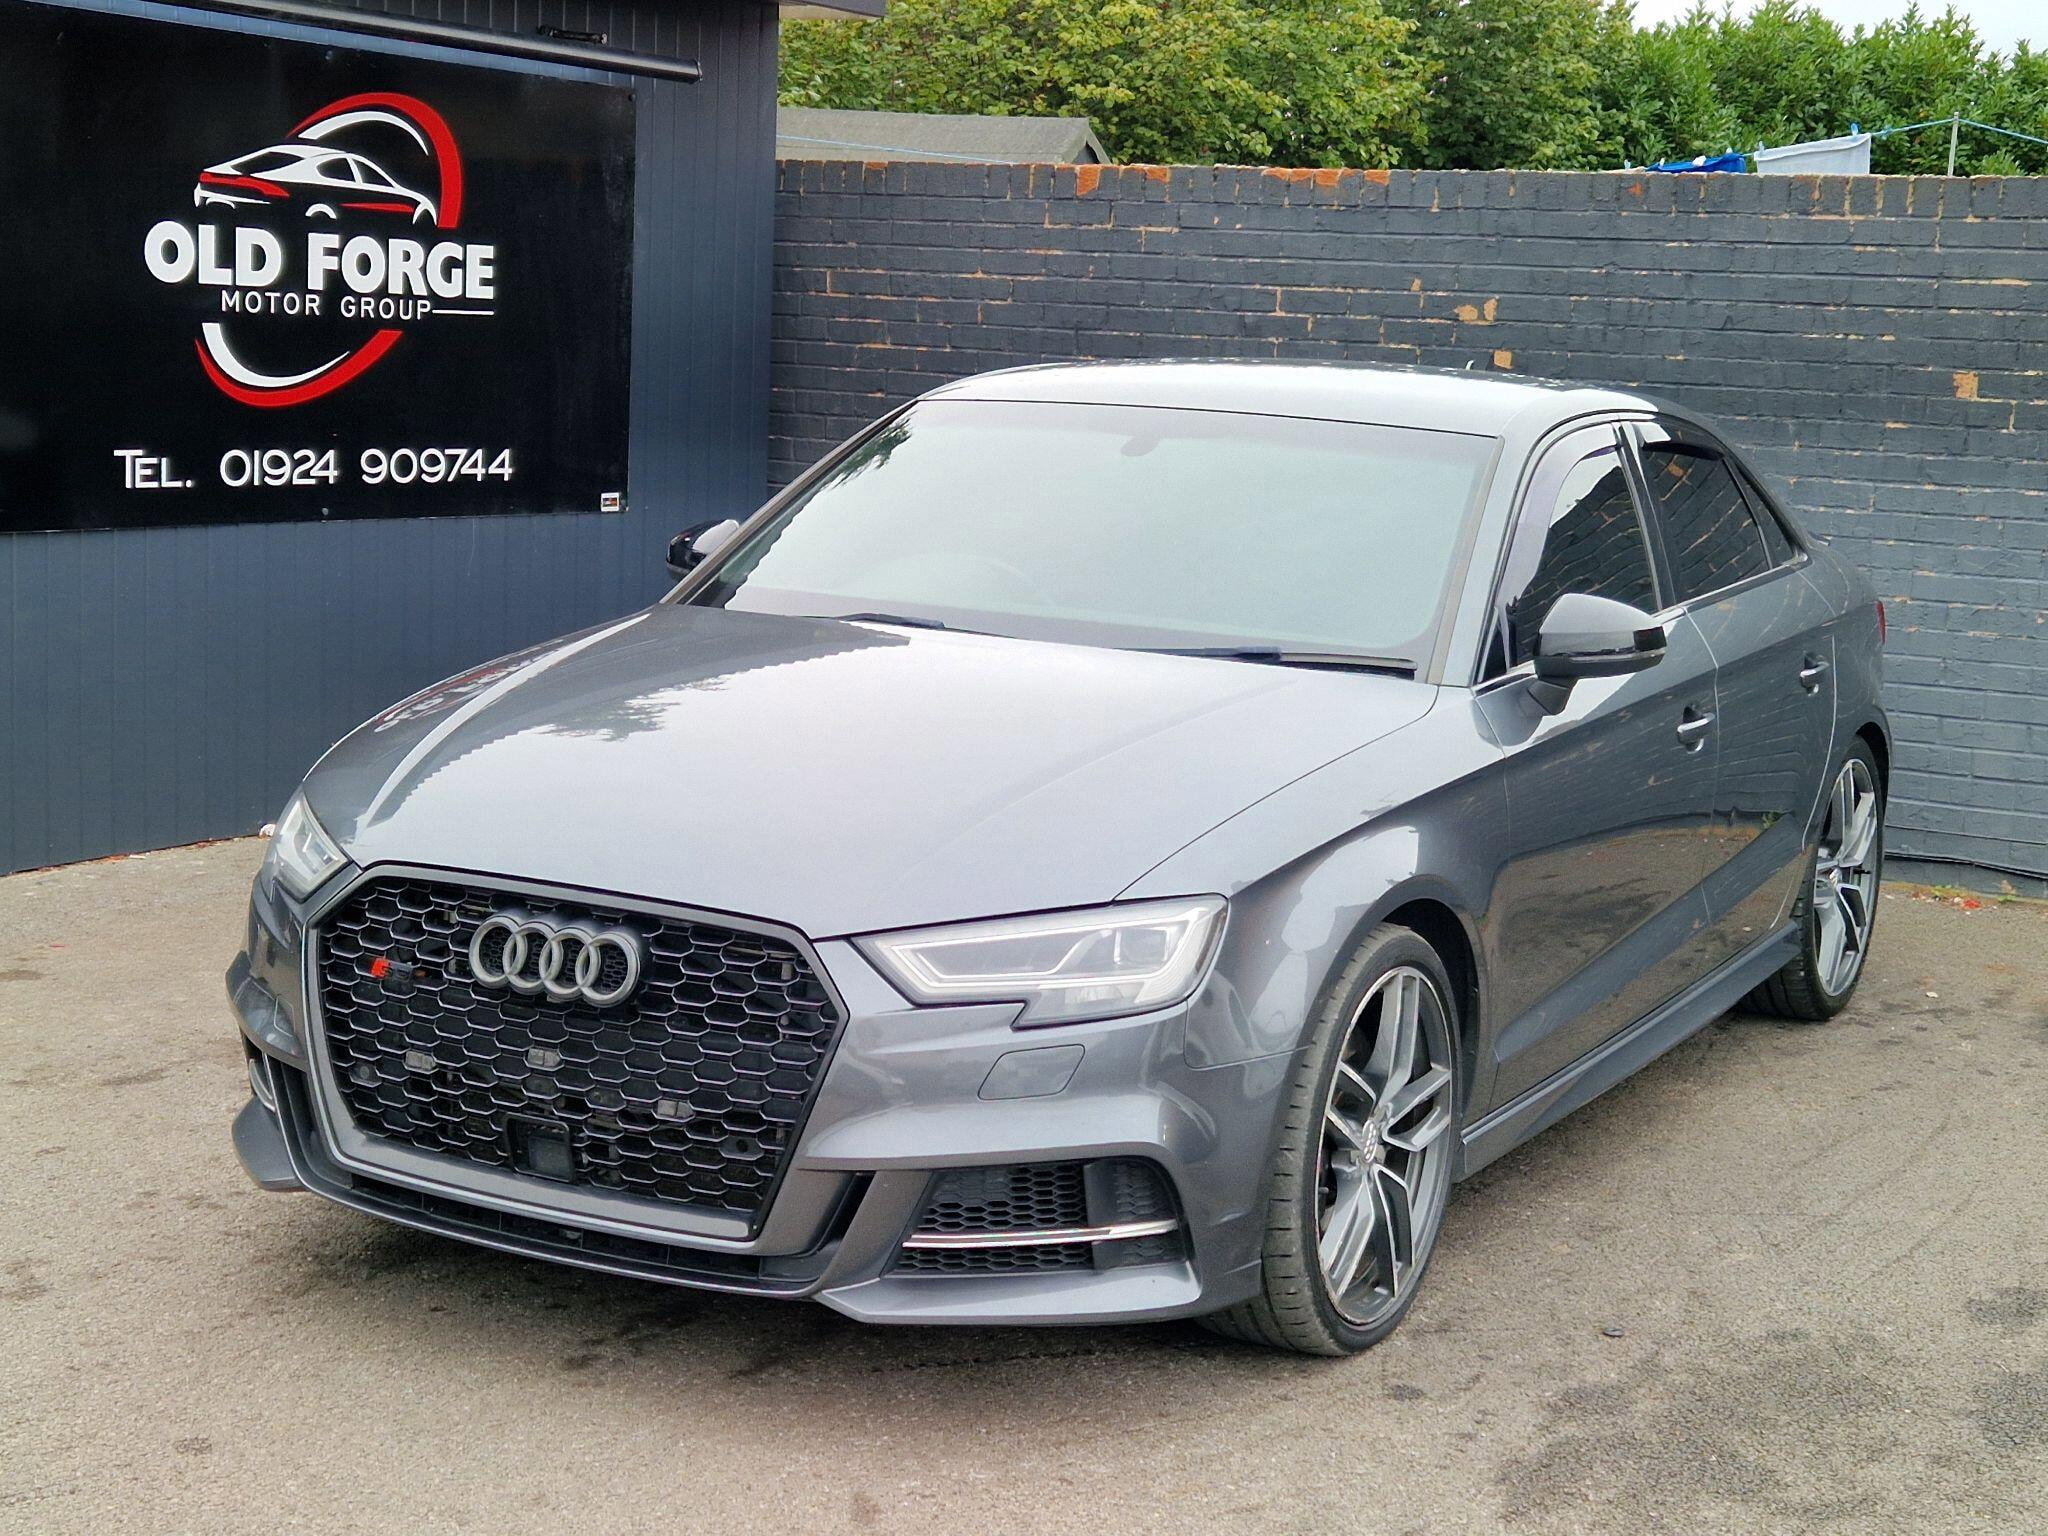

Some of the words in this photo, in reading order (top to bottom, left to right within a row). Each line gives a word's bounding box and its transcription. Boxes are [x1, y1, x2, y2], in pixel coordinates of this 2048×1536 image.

[143, 220, 284, 286] OLD
[307, 232, 495, 300] FORGE
[221, 290, 321, 316] MOTOR
[340, 295, 432, 321] GROUP
[113, 449, 194, 489] TEL.
[219, 449, 340, 487] 01924
[360, 448, 514, 485] 909744
